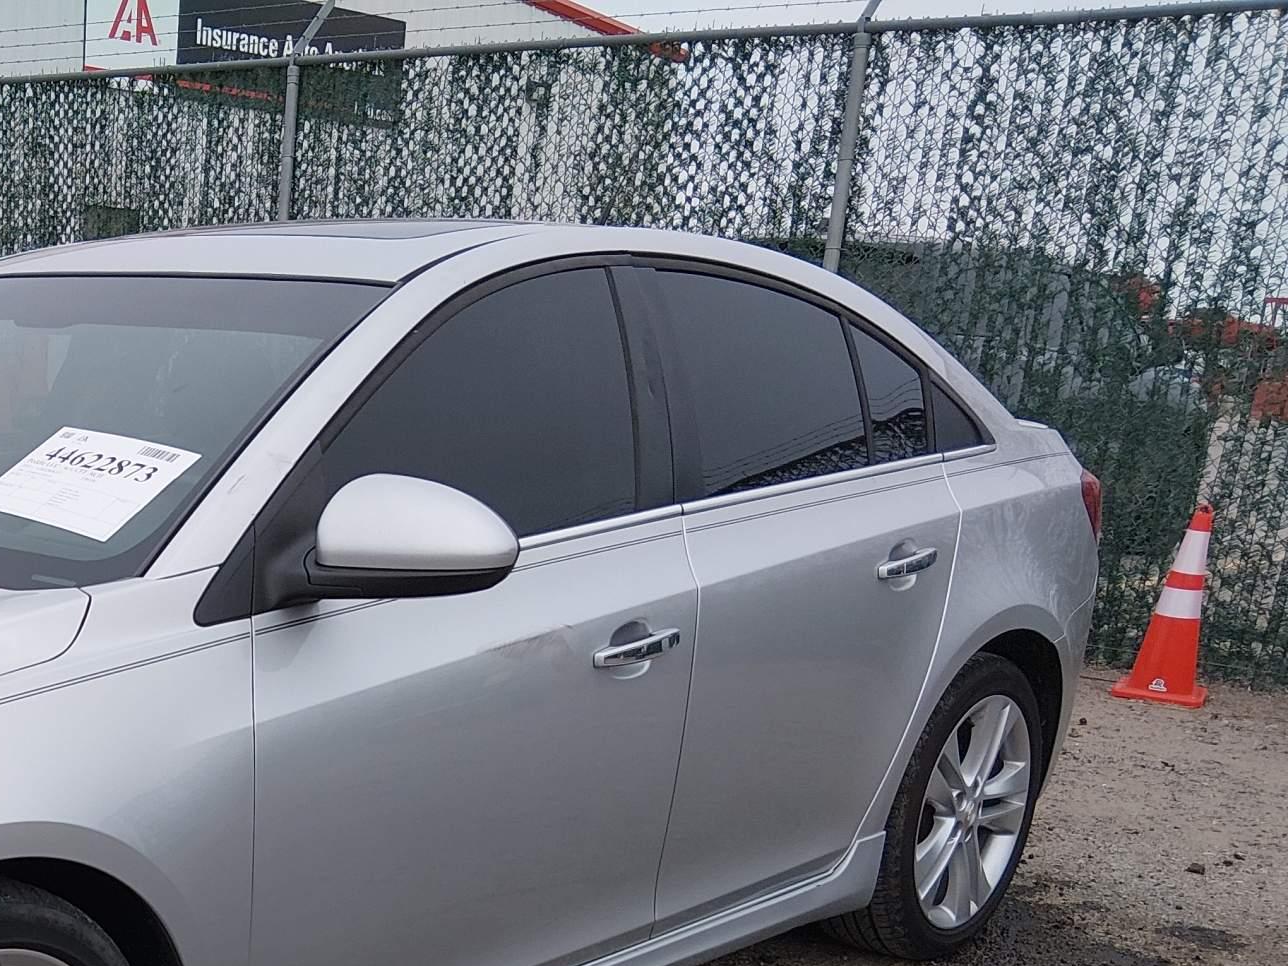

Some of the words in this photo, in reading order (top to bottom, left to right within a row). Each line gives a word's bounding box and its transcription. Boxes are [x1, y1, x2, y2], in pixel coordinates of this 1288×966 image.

[196, 17, 279, 58] Insurance
[283, 34, 319, 58] Ato
[45, 446, 159, 483] 44622873
